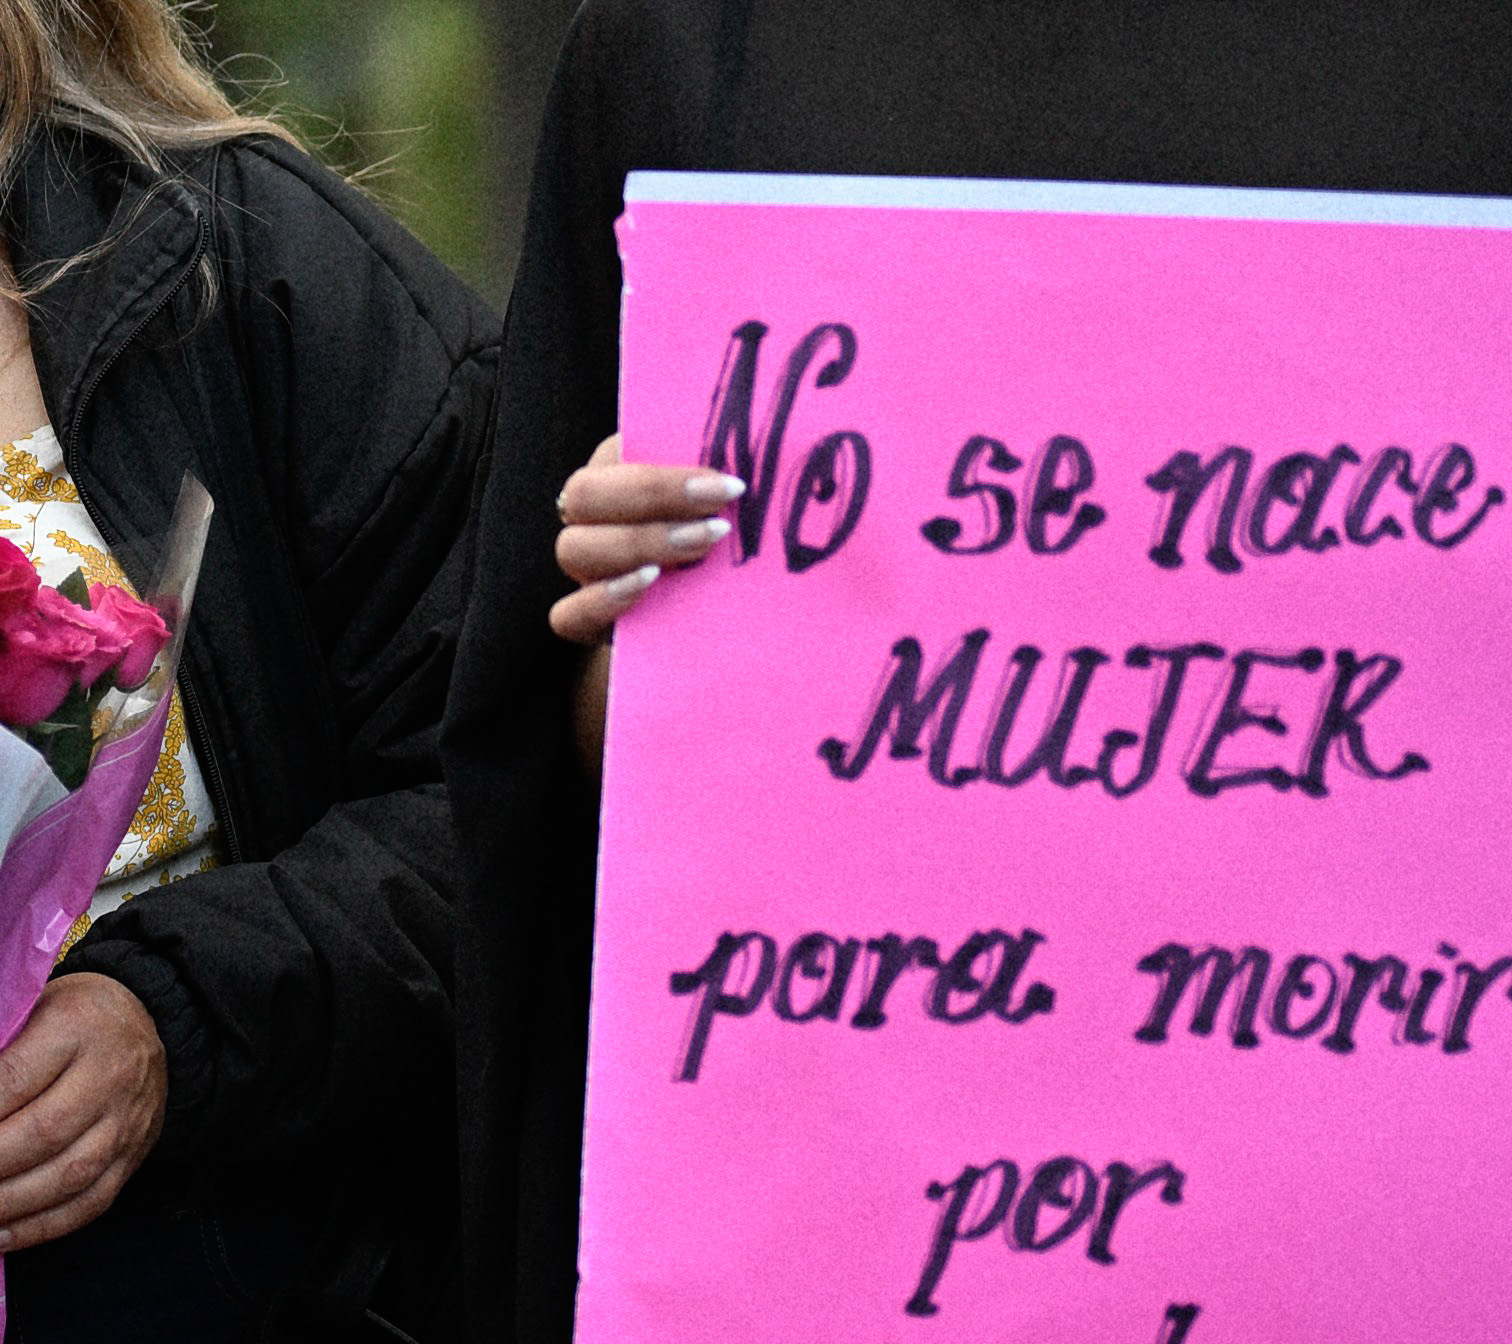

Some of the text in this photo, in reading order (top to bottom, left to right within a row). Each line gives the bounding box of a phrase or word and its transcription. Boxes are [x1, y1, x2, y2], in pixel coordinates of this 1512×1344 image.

[700, 320, 1505, 574] No se nace
[818, 628, 1431, 799] MUJER
[670, 926, 1056, 1082] para
[905, 1156, 1184, 1316] por
